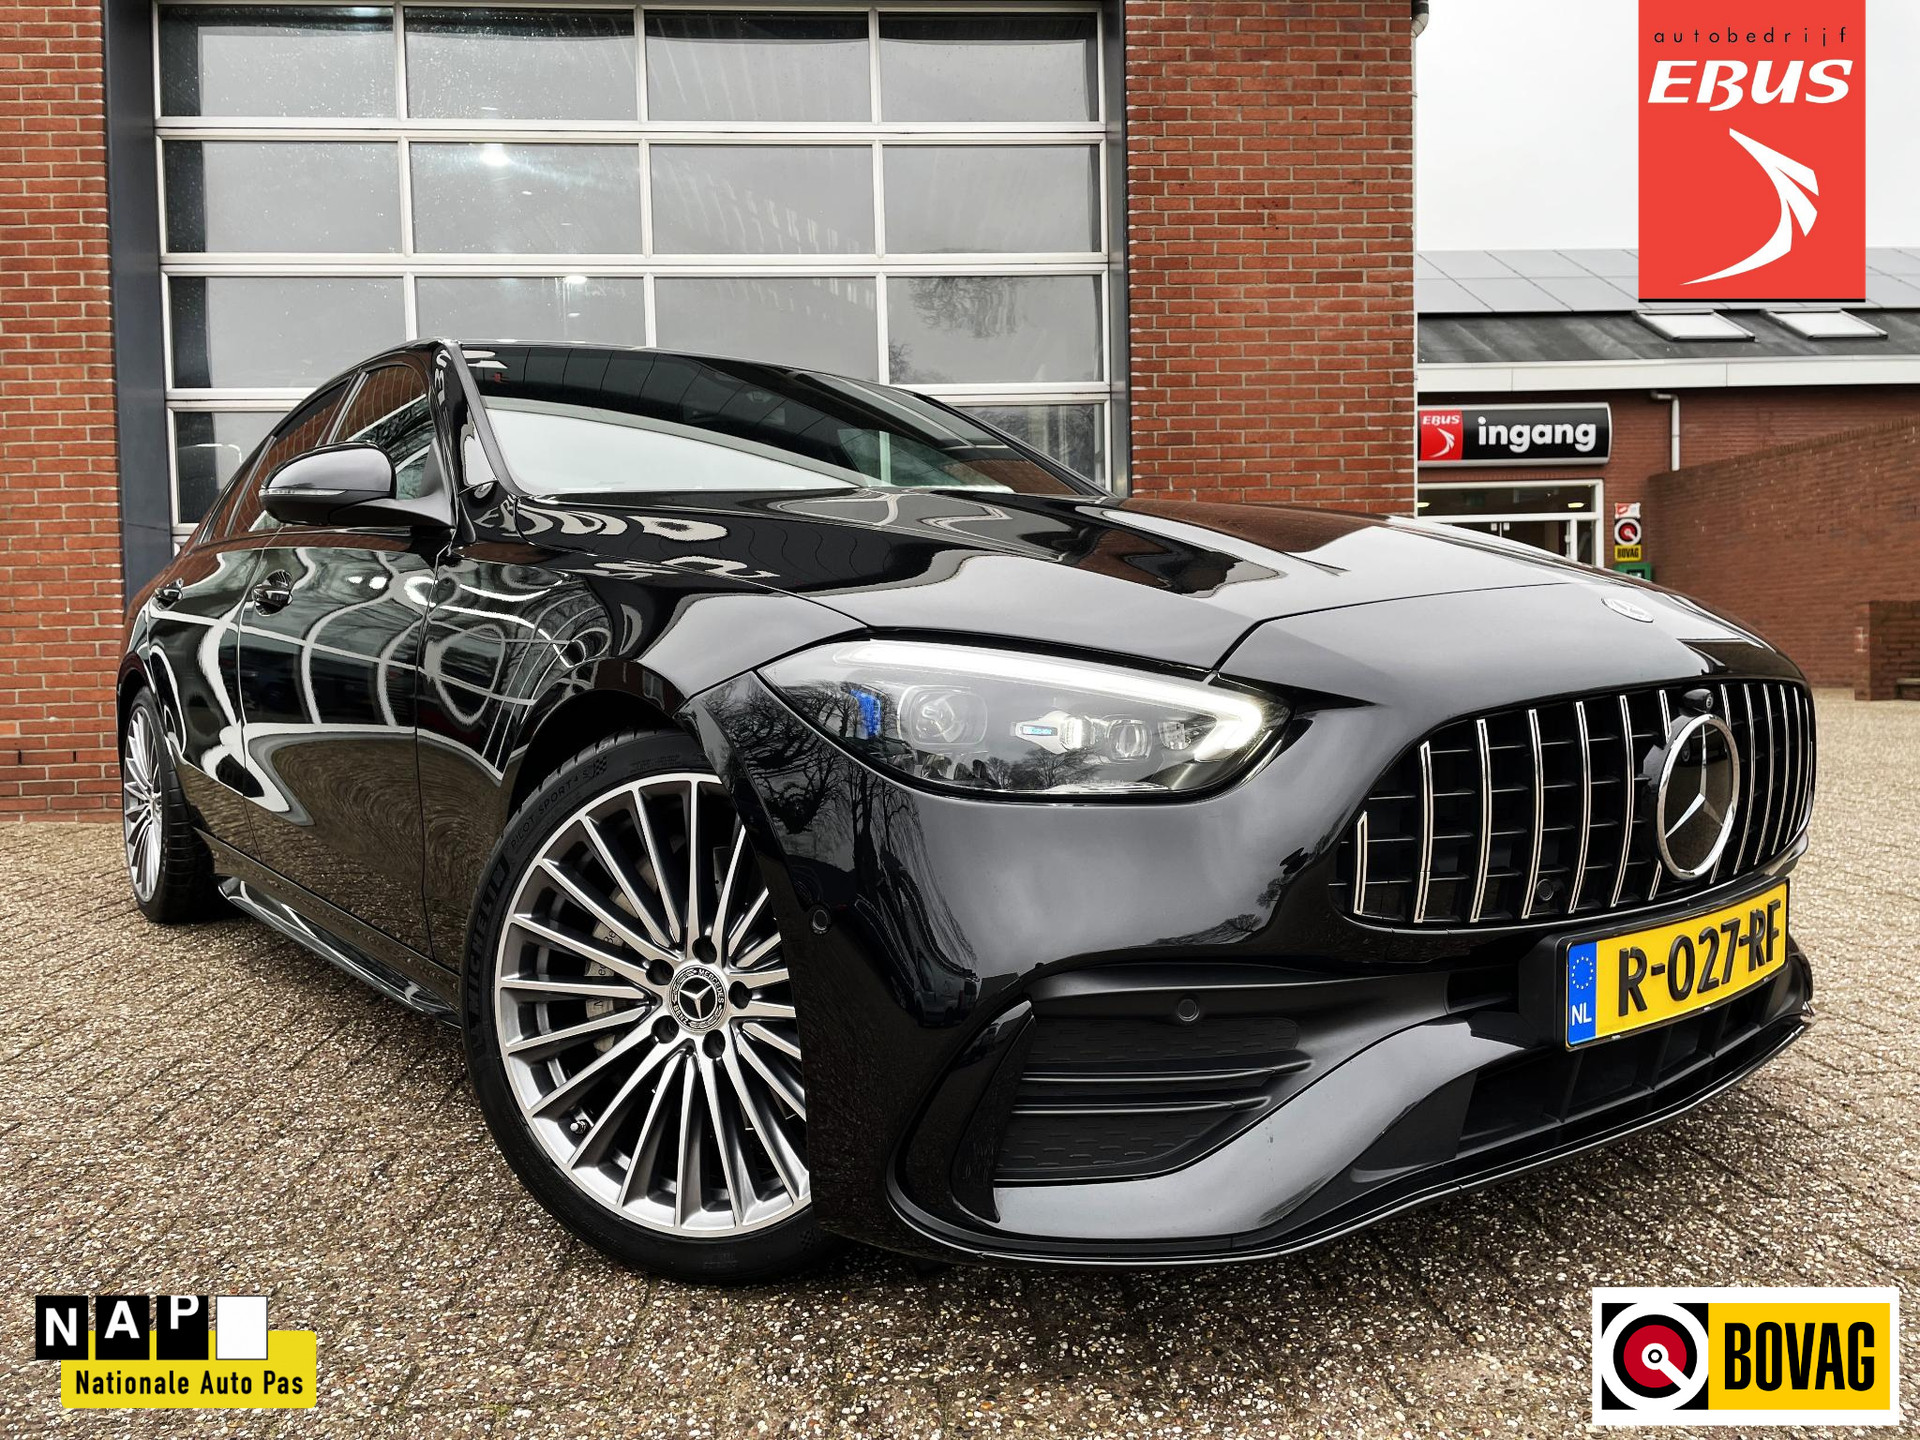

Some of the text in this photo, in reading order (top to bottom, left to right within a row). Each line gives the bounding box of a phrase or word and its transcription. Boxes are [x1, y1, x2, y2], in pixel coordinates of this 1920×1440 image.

[1422, 415, 1460, 426] EBUS
[1477, 416, 1596, 453] ingang
[1617, 547, 1639, 558] BOVAG
[510, 816, 536, 850] PILOT
[538, 781, 573, 815] SPORT
[467, 853, 510, 1010] MICHELIN
[1618, 899, 1781, 1017] R-027-RF
[698, 968, 725, 1004] MERCEDES
[673, 1004, 689, 1025] BENZ
[1571, 1002, 1592, 1027] NL
